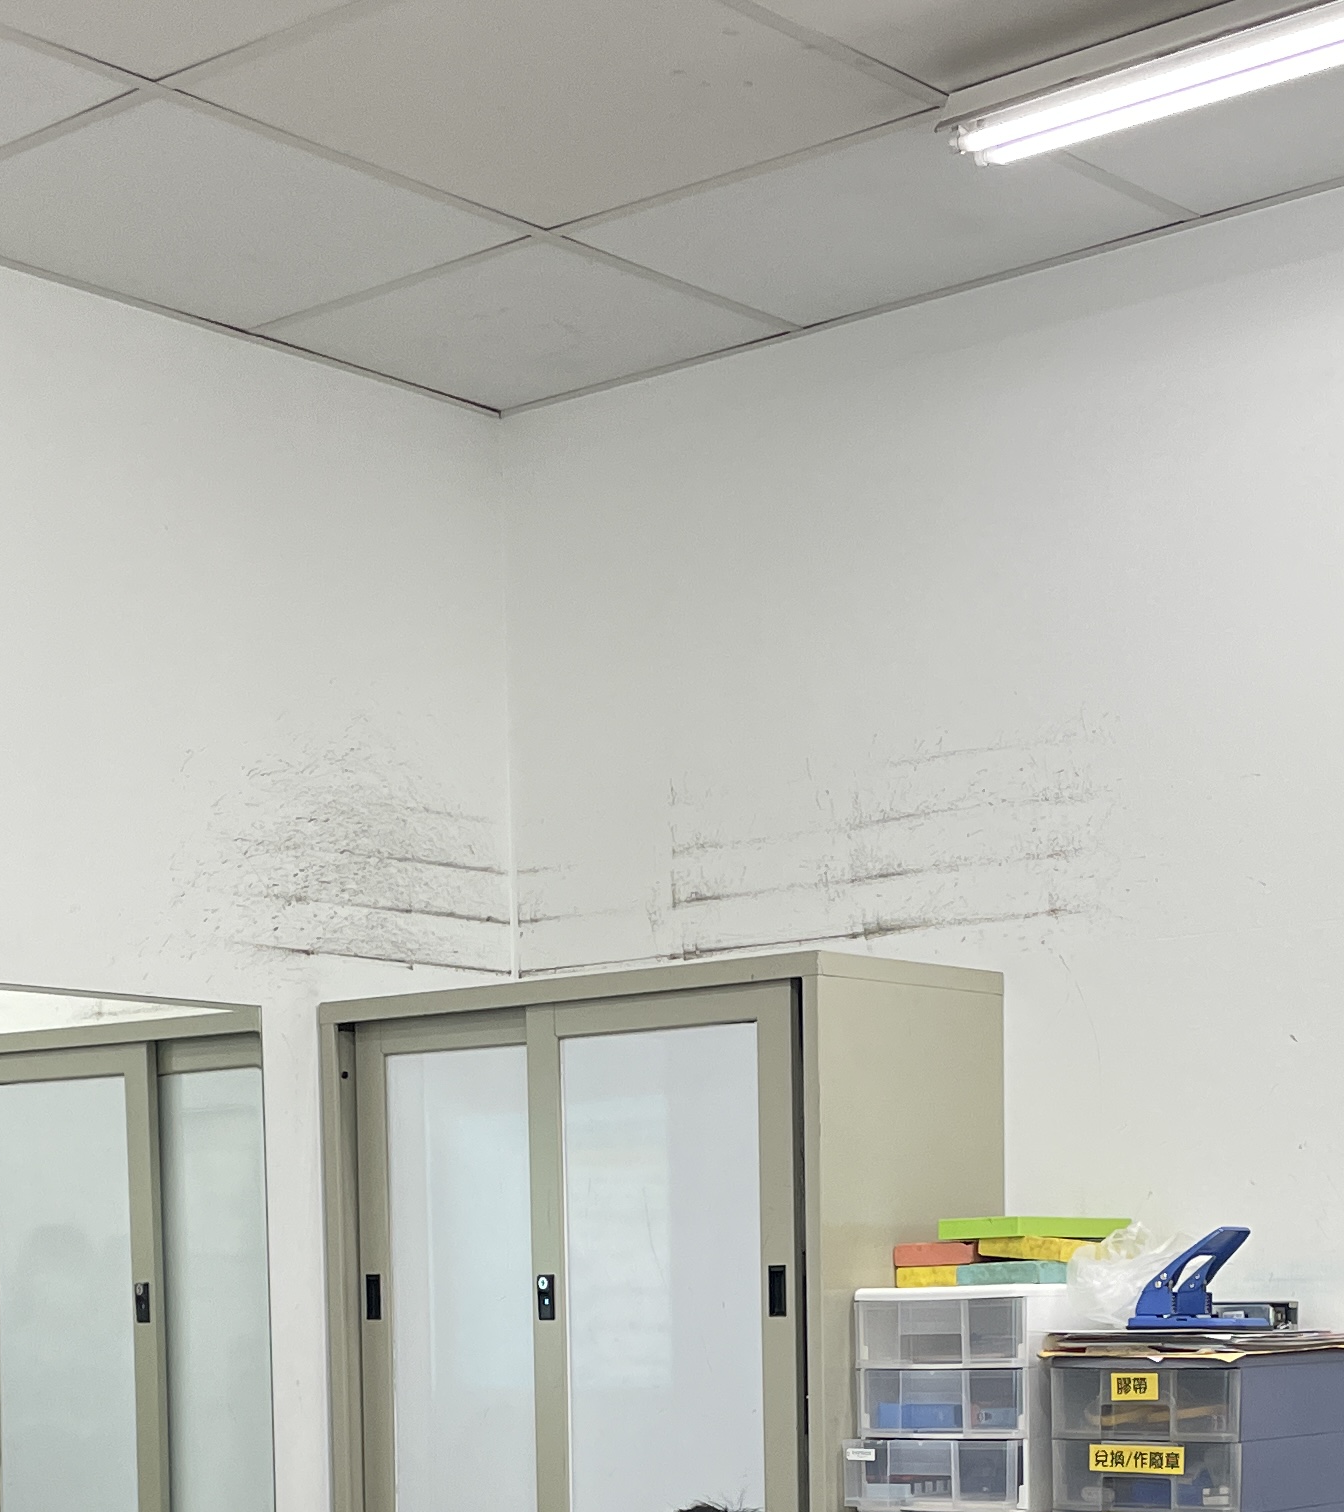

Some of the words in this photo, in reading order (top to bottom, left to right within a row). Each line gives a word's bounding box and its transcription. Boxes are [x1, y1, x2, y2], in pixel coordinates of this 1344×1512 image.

[1116, 1377, 1148, 1395] 膠帶
[1094, 1450, 1180, 1470] 兌換/作廢章
